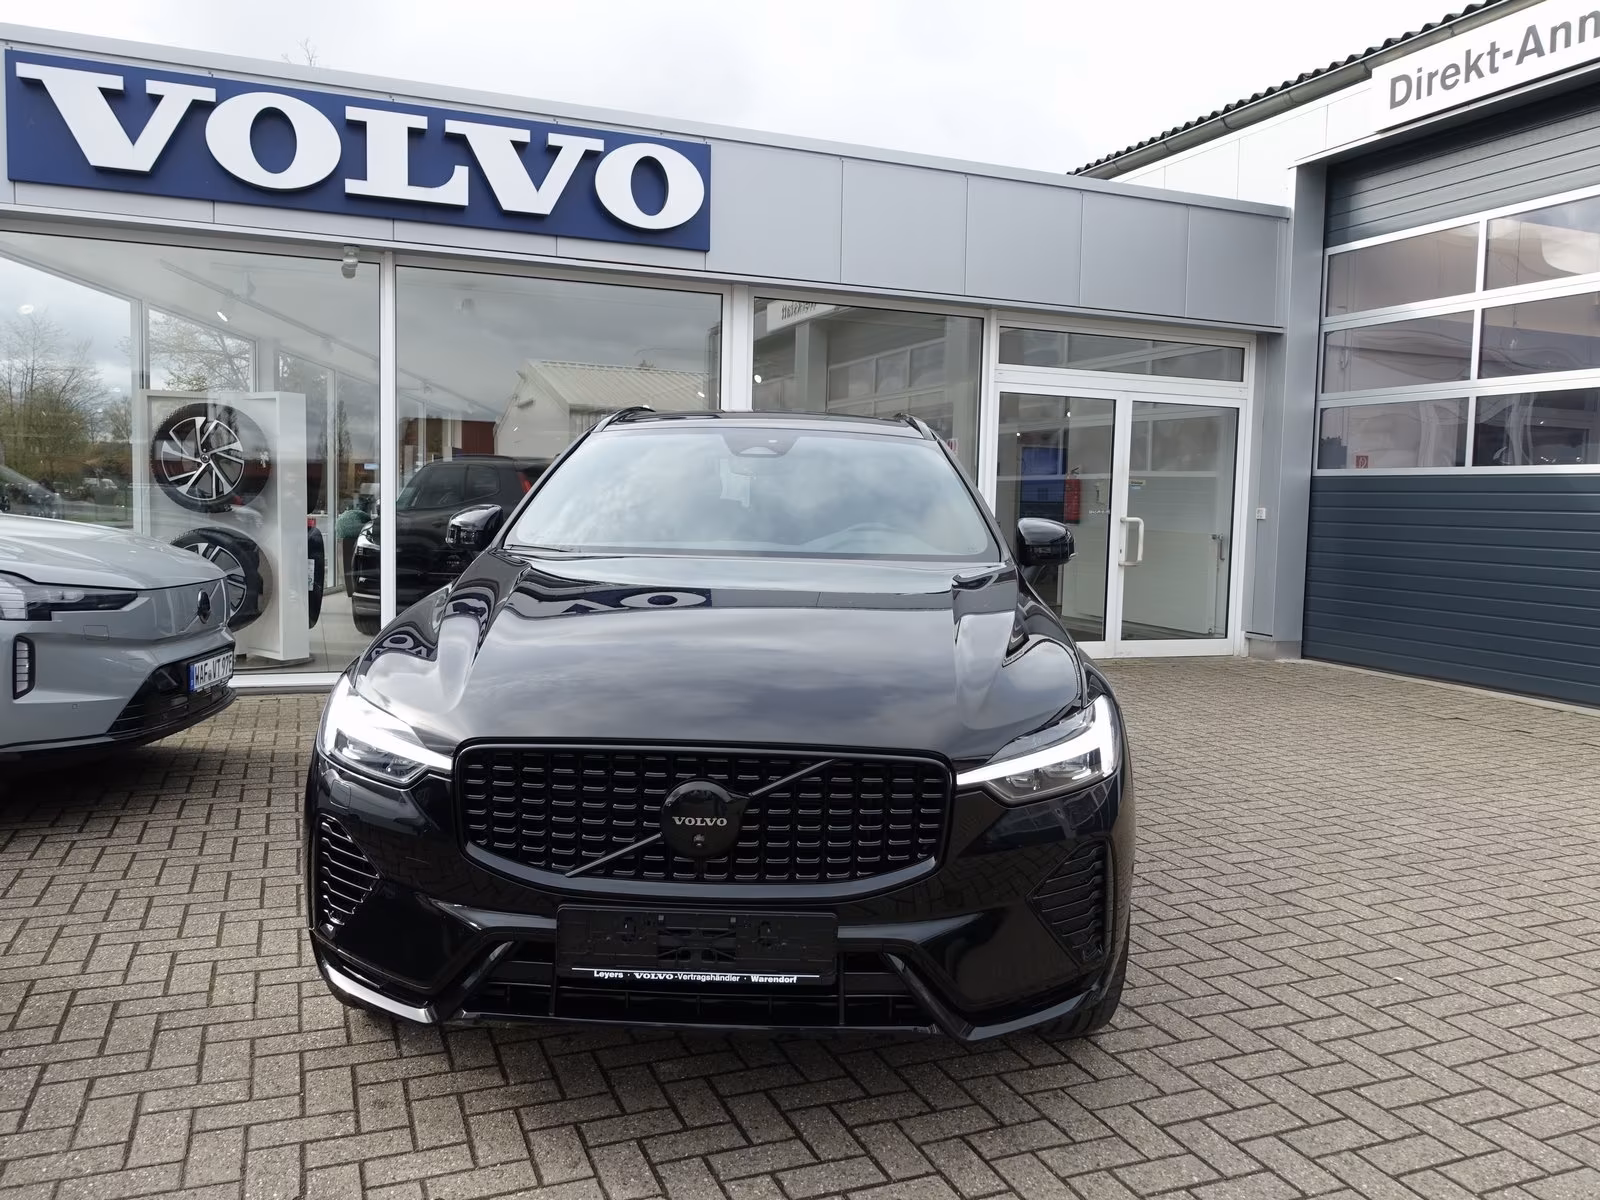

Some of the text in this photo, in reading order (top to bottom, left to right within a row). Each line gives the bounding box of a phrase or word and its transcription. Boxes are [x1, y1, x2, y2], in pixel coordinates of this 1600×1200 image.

[15, 62, 705, 230] VOLVO
[195, 662, 208, 686] WAF
[672, 816, 728, 827] VOLVO
[594, 970, 624, 979] Leyers
[751, 975, 798, 983] Warendorf
